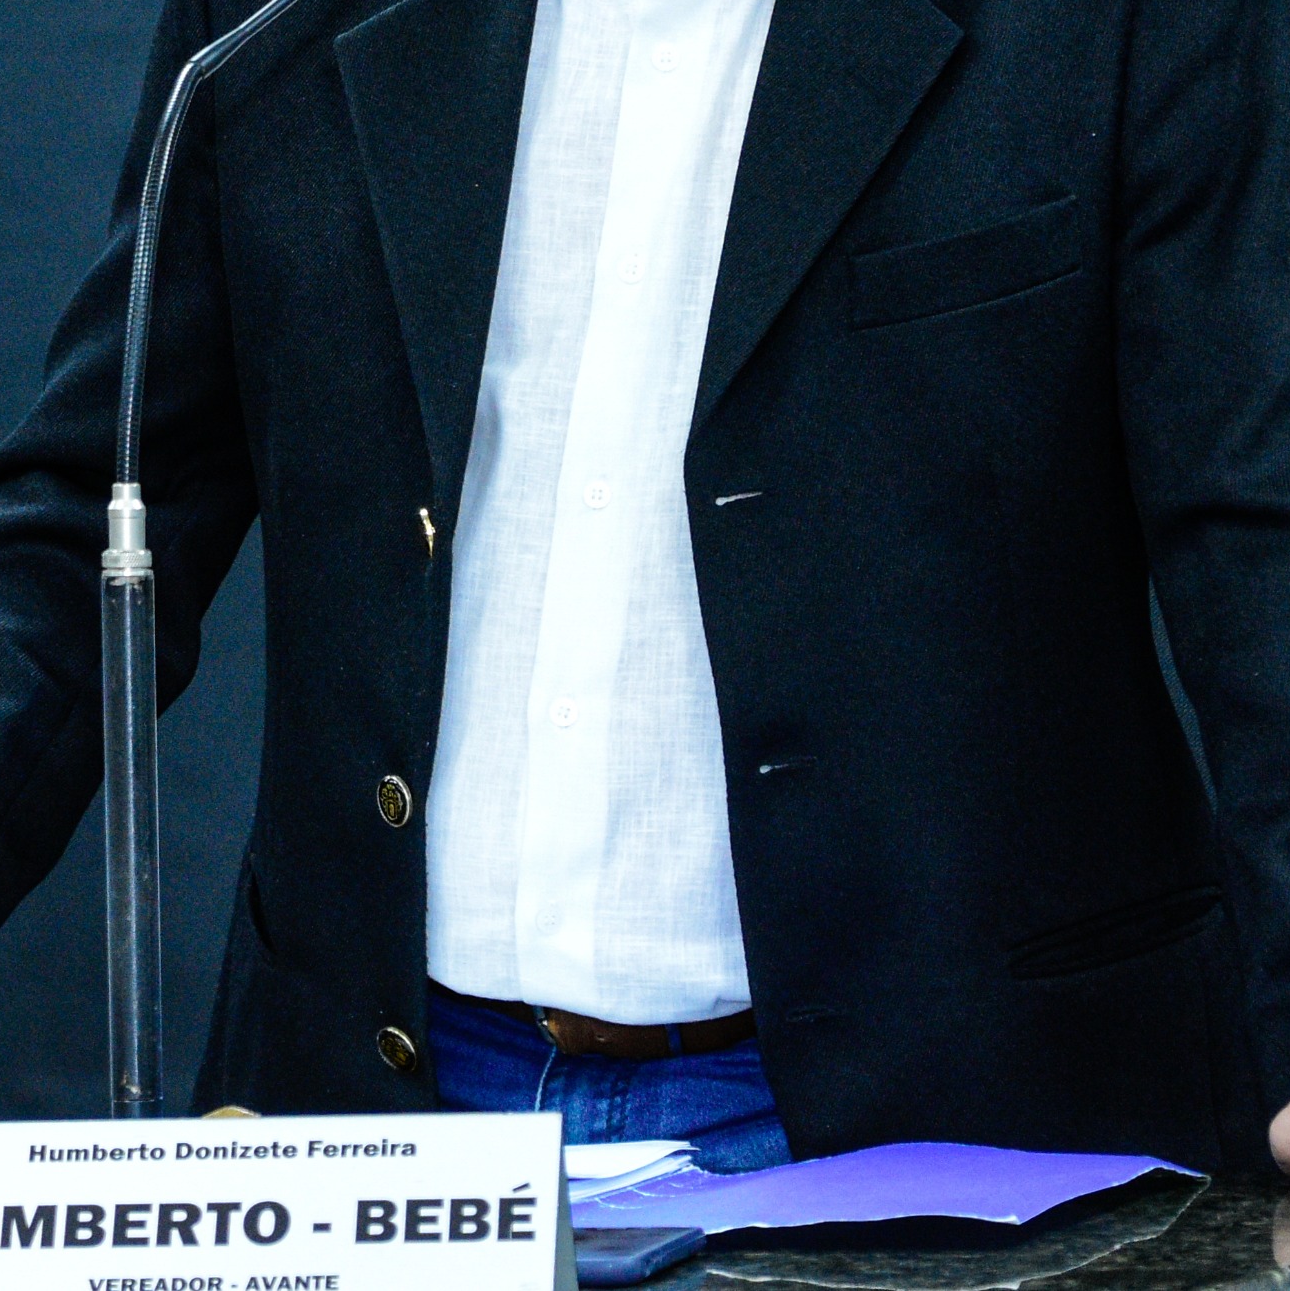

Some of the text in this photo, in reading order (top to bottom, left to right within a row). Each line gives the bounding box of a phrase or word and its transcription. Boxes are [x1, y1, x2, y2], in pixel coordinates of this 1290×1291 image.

[28, 1138, 417, 1163] Humberto Donizete Ferreira
[312, 1222, 332, 1233] -
[354, 1182, 538, 1244] BEBÉ
[88, 1277, 223, 1291] VEREADOR
[245, 1275, 340, 1290] AVANTE
